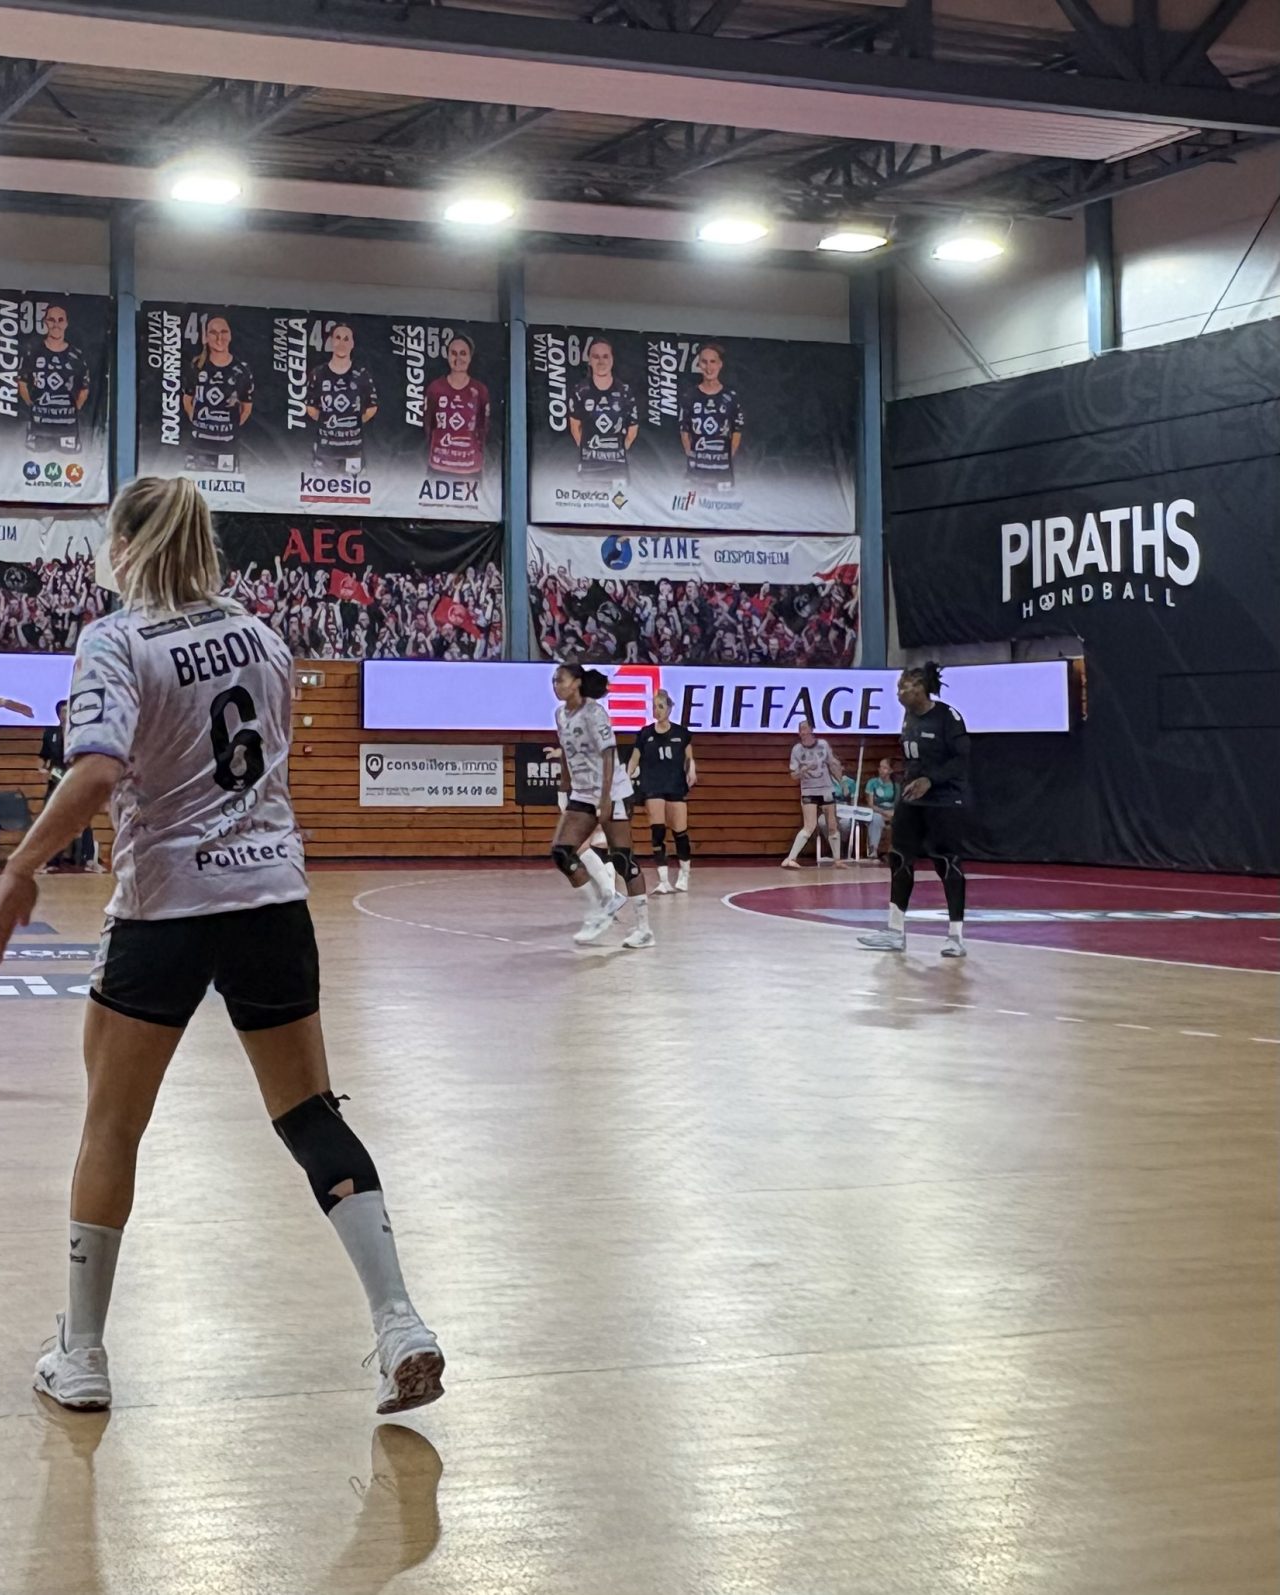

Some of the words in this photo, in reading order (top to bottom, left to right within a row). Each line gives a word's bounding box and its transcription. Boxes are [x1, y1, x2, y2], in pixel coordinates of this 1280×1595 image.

[20, 301, 49, 334] 35
[148, 311, 161, 368] OLIVIA
[273, 318, 288, 373] EMMA
[390, 325, 407, 356] LÉA
[161, 311, 182, 446] ROUGE-CARRASSAT
[287, 318, 308, 430] TUCCELLA
[406, 325, 425, 427] FARGUES
[534, 333, 548, 372] LINA
[660, 340, 678, 417] IMHOF
[547, 333, 567, 432] COLINOT
[648, 341, 661, 426] MARGAUX
[300, 472, 371, 494] koesio
[419, 480, 479, 501] ADEX
[283, 528, 365, 564] AEG
[1001, 499, 1200, 603] PIRATHS
[170, 627, 270, 687] BEGON
[681, 684, 883, 730] EIFFAGE
[210, 685, 265, 792] 6
